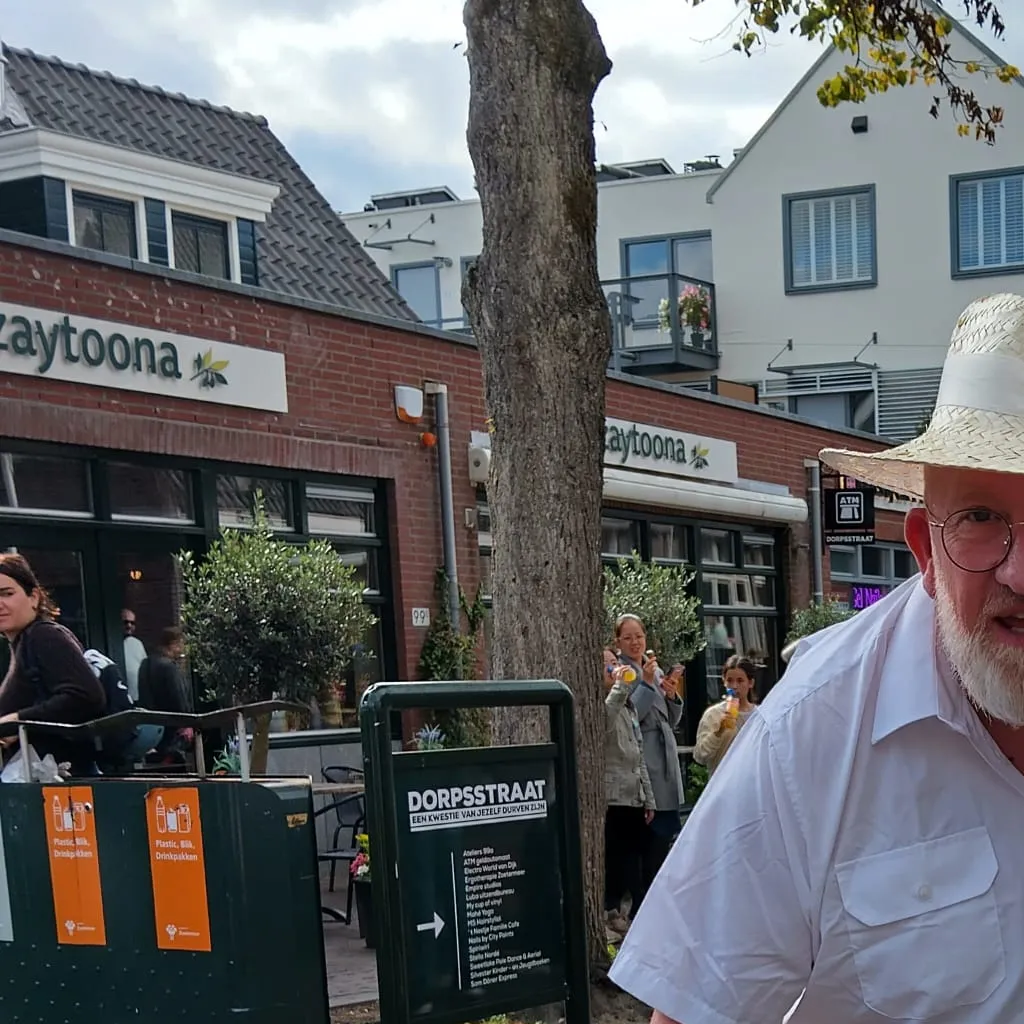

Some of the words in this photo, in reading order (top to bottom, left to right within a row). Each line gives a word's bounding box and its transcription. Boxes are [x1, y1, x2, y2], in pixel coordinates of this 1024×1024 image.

[604, 424, 687, 464] aytoona
[839, 496, 860, 505] ATM
[826, 535, 874, 543] DORPSSTRAAT
[407, 780, 546, 812] DORPSSTRAAT
[411, 815, 427, 824] EEN
[428, 811, 460, 823] KWESTIE
[461, 809, 476, 819] VAN
[476, 807, 502, 817] JEZELF
[502, 804, 530, 814] DURVEN
[530, 802, 546, 811] ZIJN
[155, 852, 198, 863] Drinkpakken
[482, 864, 497, 872] World
